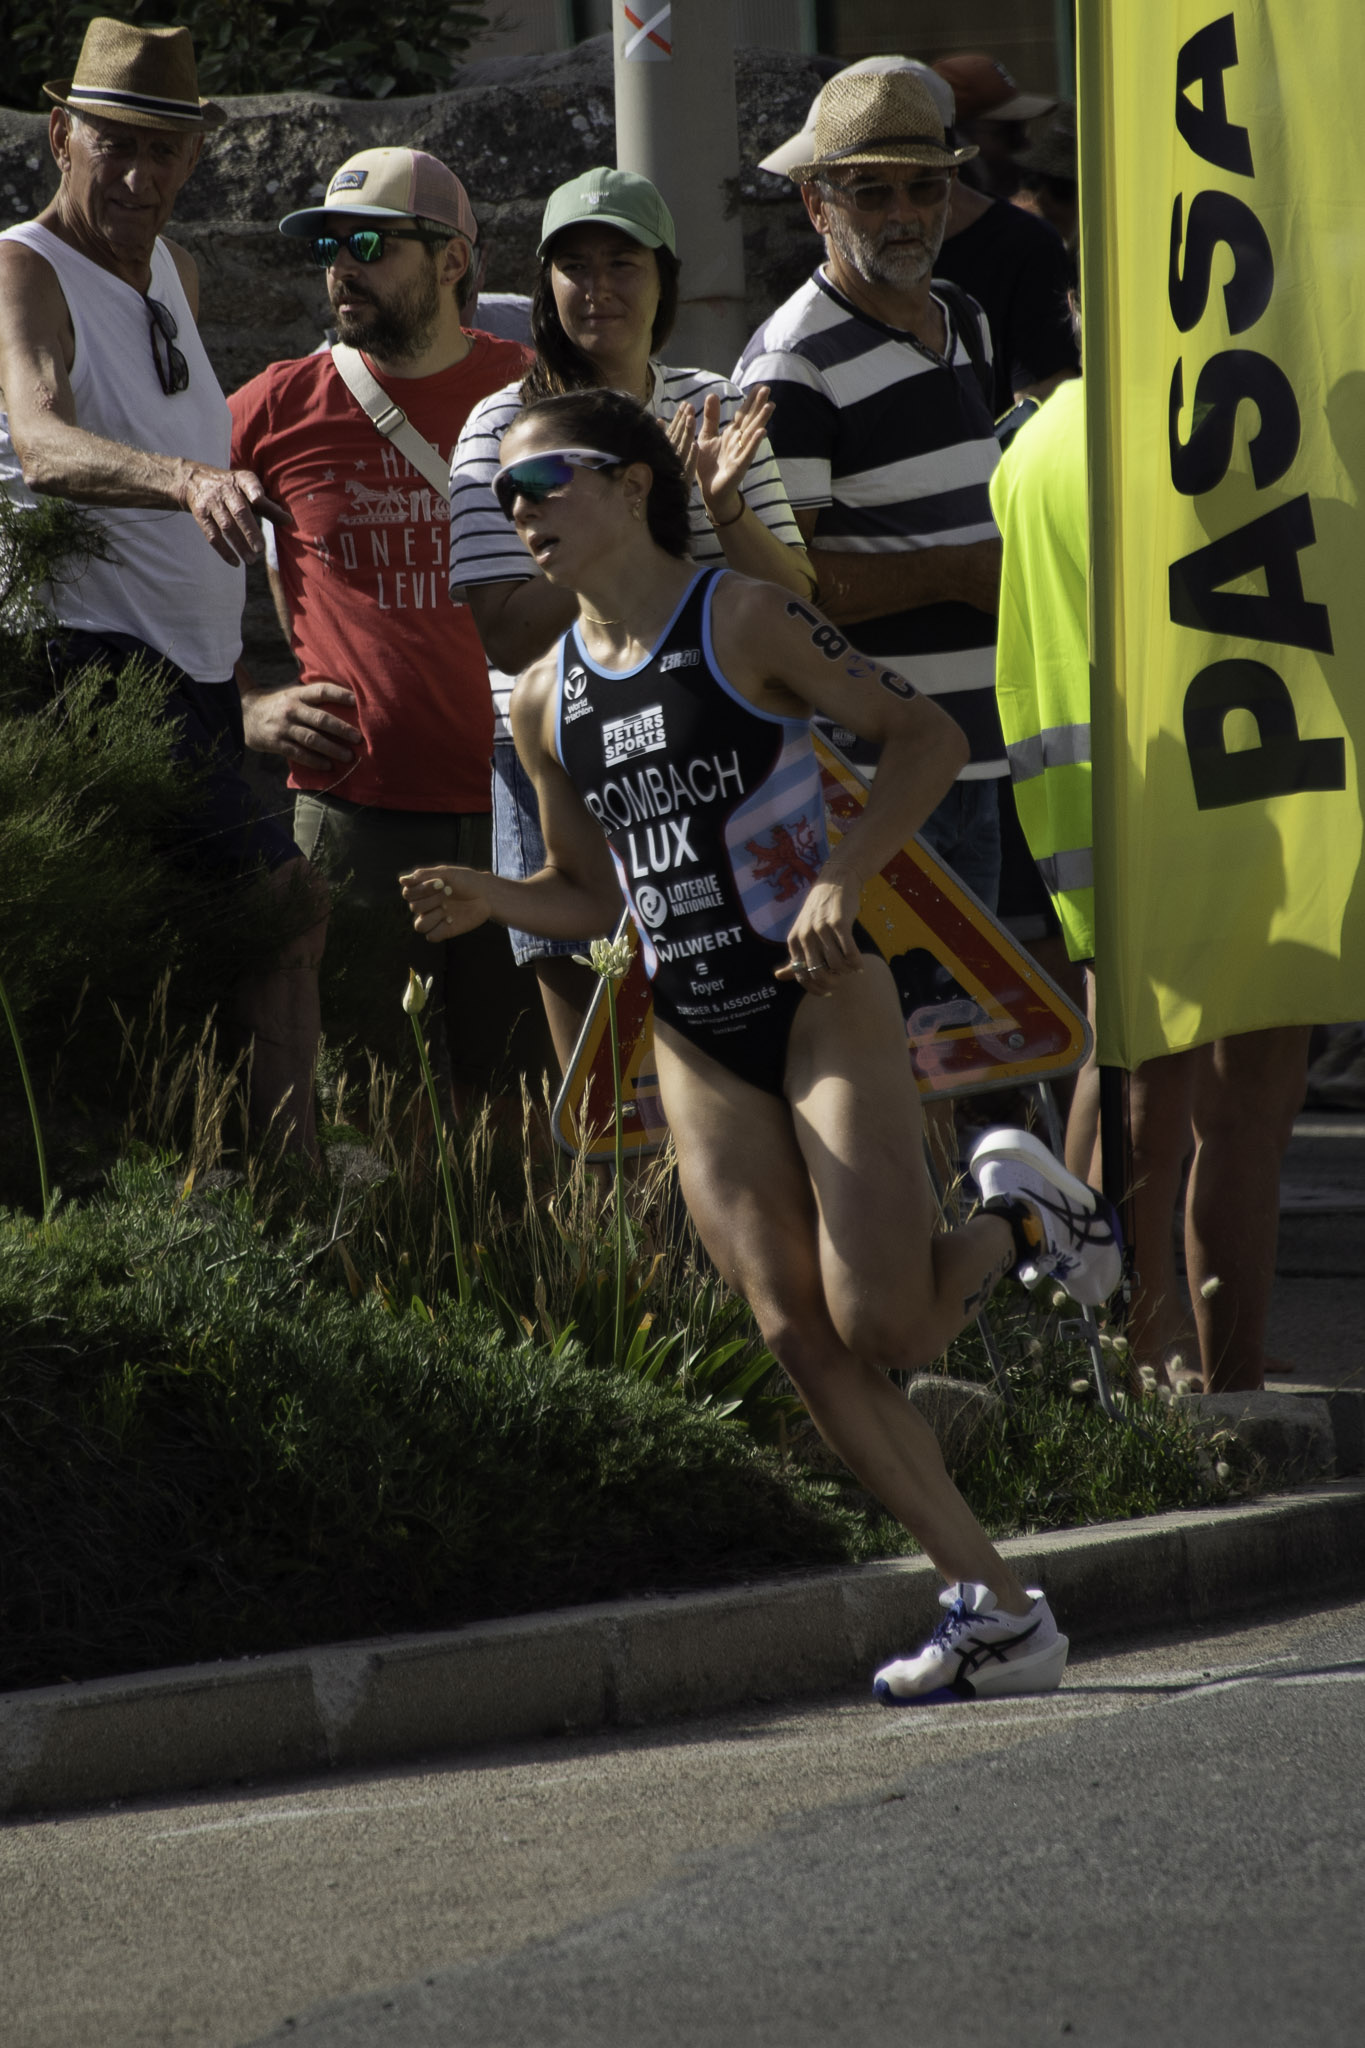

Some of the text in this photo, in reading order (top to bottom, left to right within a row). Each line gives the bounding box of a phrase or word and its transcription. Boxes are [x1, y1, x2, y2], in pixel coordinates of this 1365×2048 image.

[1169, 12, 1346, 811] PASSA
[377, 571, 462, 609] LEVI'
[786, 601, 849, 662] 18
[564, 706, 594, 725] Triathlon
[567, 697, 588, 714] World
[603, 714, 664, 746] PETERS
[605, 728, 666, 760] SPORTS
[584, 751, 744, 838] ROMBACH
[628, 816, 699, 879] LUX
[666, 874, 720, 904] LOTERIE
[672, 892, 725, 917] NATIONALE
[655, 926, 743, 963] WILWERT
[690, 978, 725, 997] Foyer
[712, 1003, 721, 1013] &
[723, 986, 777, 1011] ASSOCIÉS
